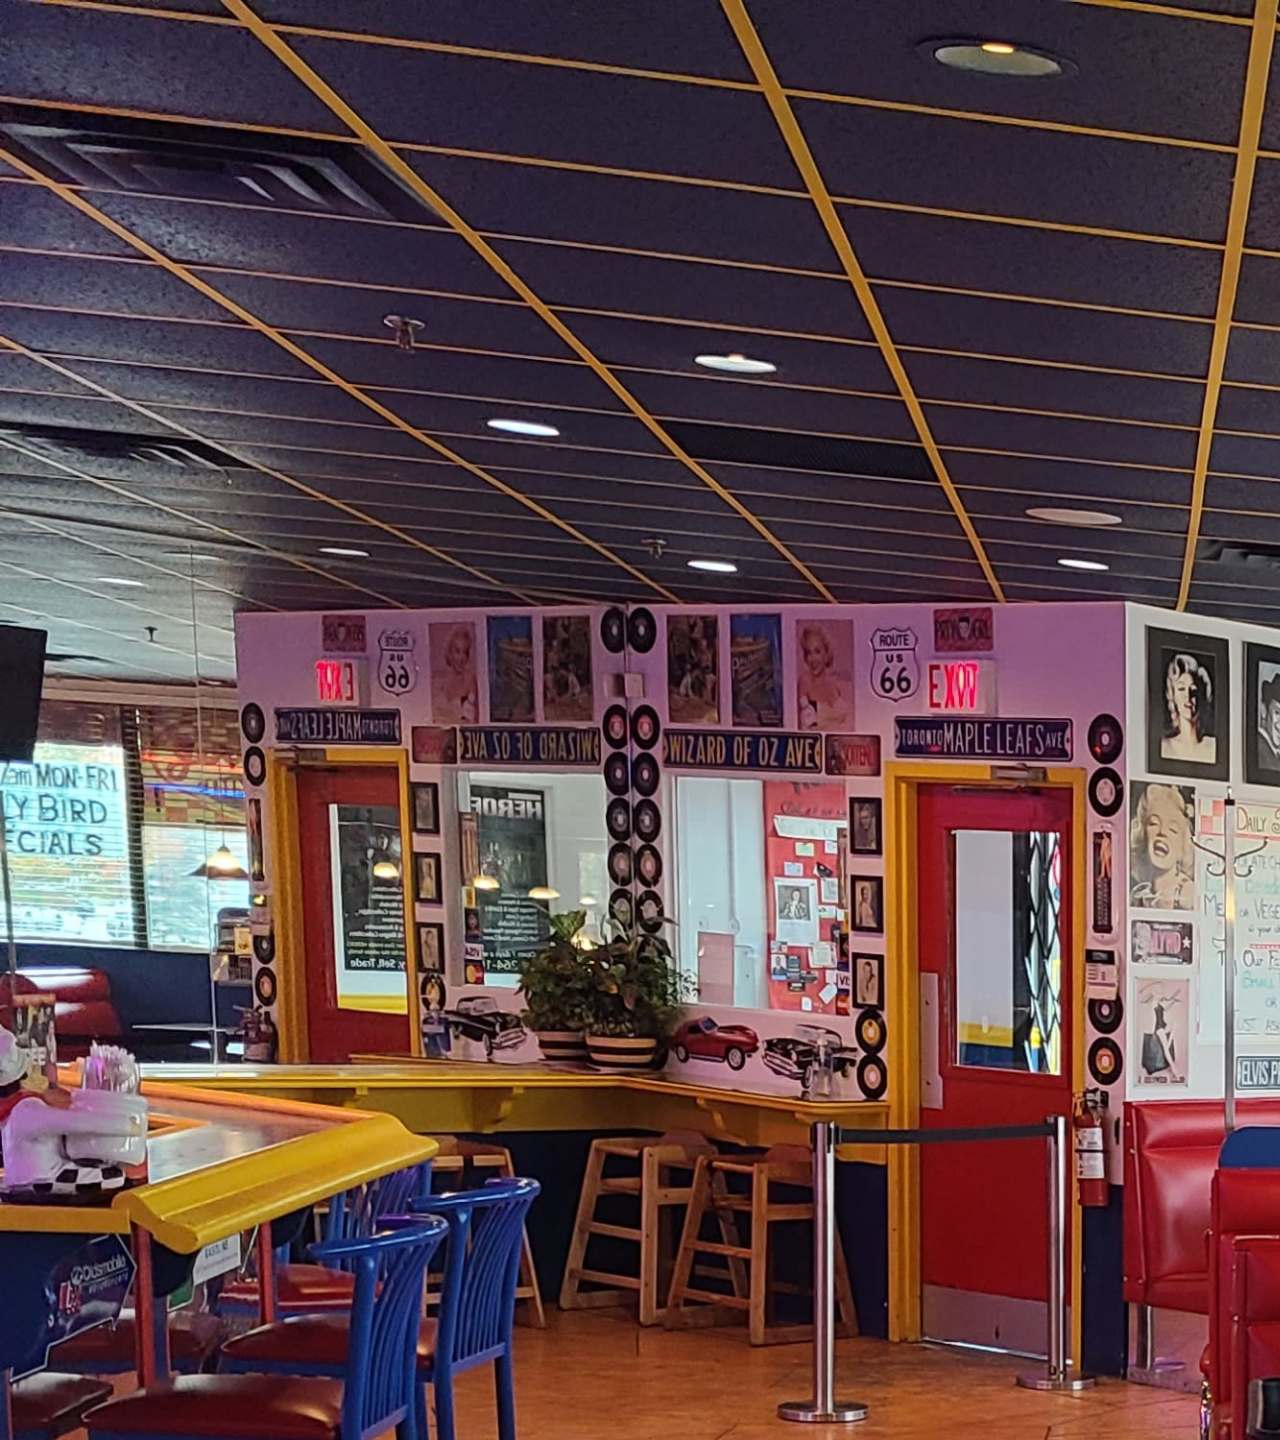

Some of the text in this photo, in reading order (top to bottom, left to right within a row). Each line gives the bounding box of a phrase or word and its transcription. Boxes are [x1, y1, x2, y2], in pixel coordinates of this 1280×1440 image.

[879, 633, 910, 646] ROUTE
[880, 667, 911, 694] 66
[928, 663, 979, 709] EXIT
[670, 735, 726, 765] WIZARD
[733, 736, 751, 766] OF
[758, 737, 779, 767] OZ
[785, 738, 815, 768] AVE
[902, 722, 1063, 756] TORONTO MAPLE LEAFS AVE
[34, 762, 119, 792] MON-FRI
[38, 793, 107, 824] BIRD
[1241, 1060, 1269, 1086] ELVIS
